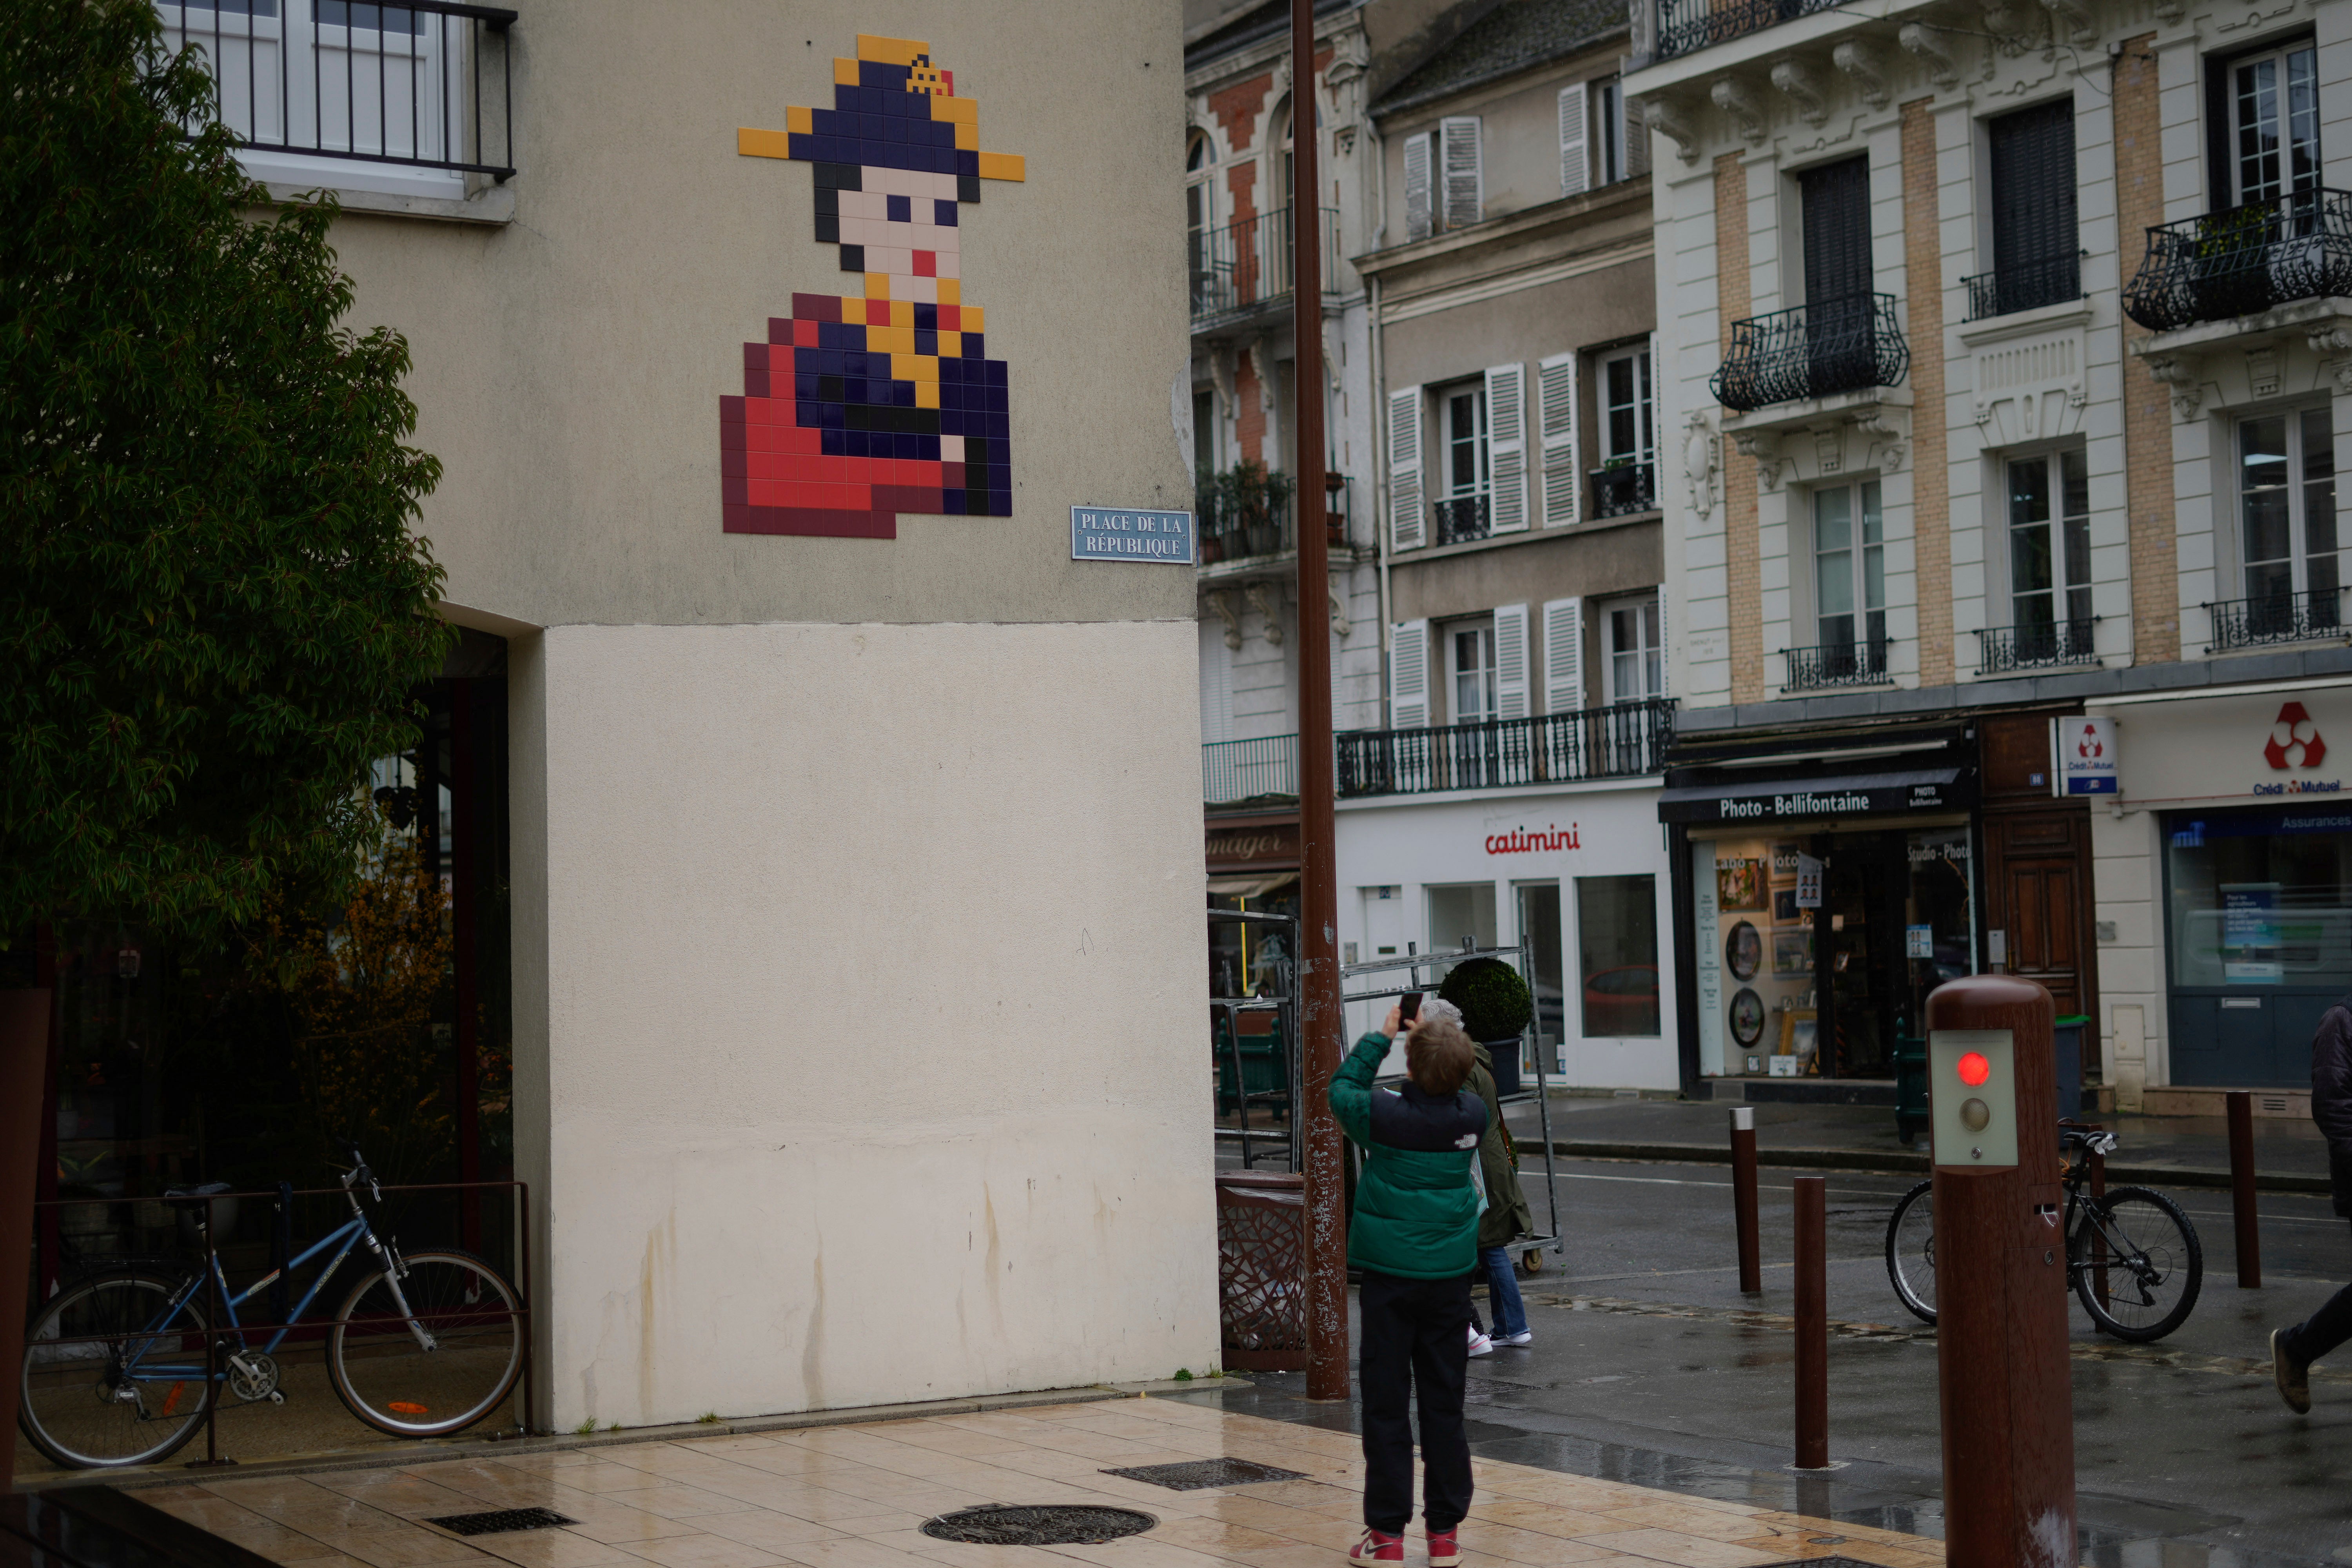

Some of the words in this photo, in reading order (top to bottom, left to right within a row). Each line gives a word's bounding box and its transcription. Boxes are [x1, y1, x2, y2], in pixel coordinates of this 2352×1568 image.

[1081, 514, 1130, 531] PLACE
[1136, 516, 1156, 532] DE
[1162, 517, 1182, 534] LA
[1085, 532, 1180, 558] RÉPUBLIQUE
[2069, 760, 2087, 770] Crédit
[2094, 761, 2113, 769] Mutuel
[1914, 786, 1936, 797] PHOTO
[2301, 779, 2340, 793] Mutuel
[1720, 798, 1762, 818] Photo
[1775, 791, 1869, 815] Bellifontaine
[2282, 816, 2352, 829] Assurances
[1486, 822, 1580, 854] catimini
[1907, 844, 1936, 861] Studio
[1944, 843, 1971, 859] Photo
[1712, 854, 1746, 870] Labo
[316, 1254, 343, 1287] DECATHLON
